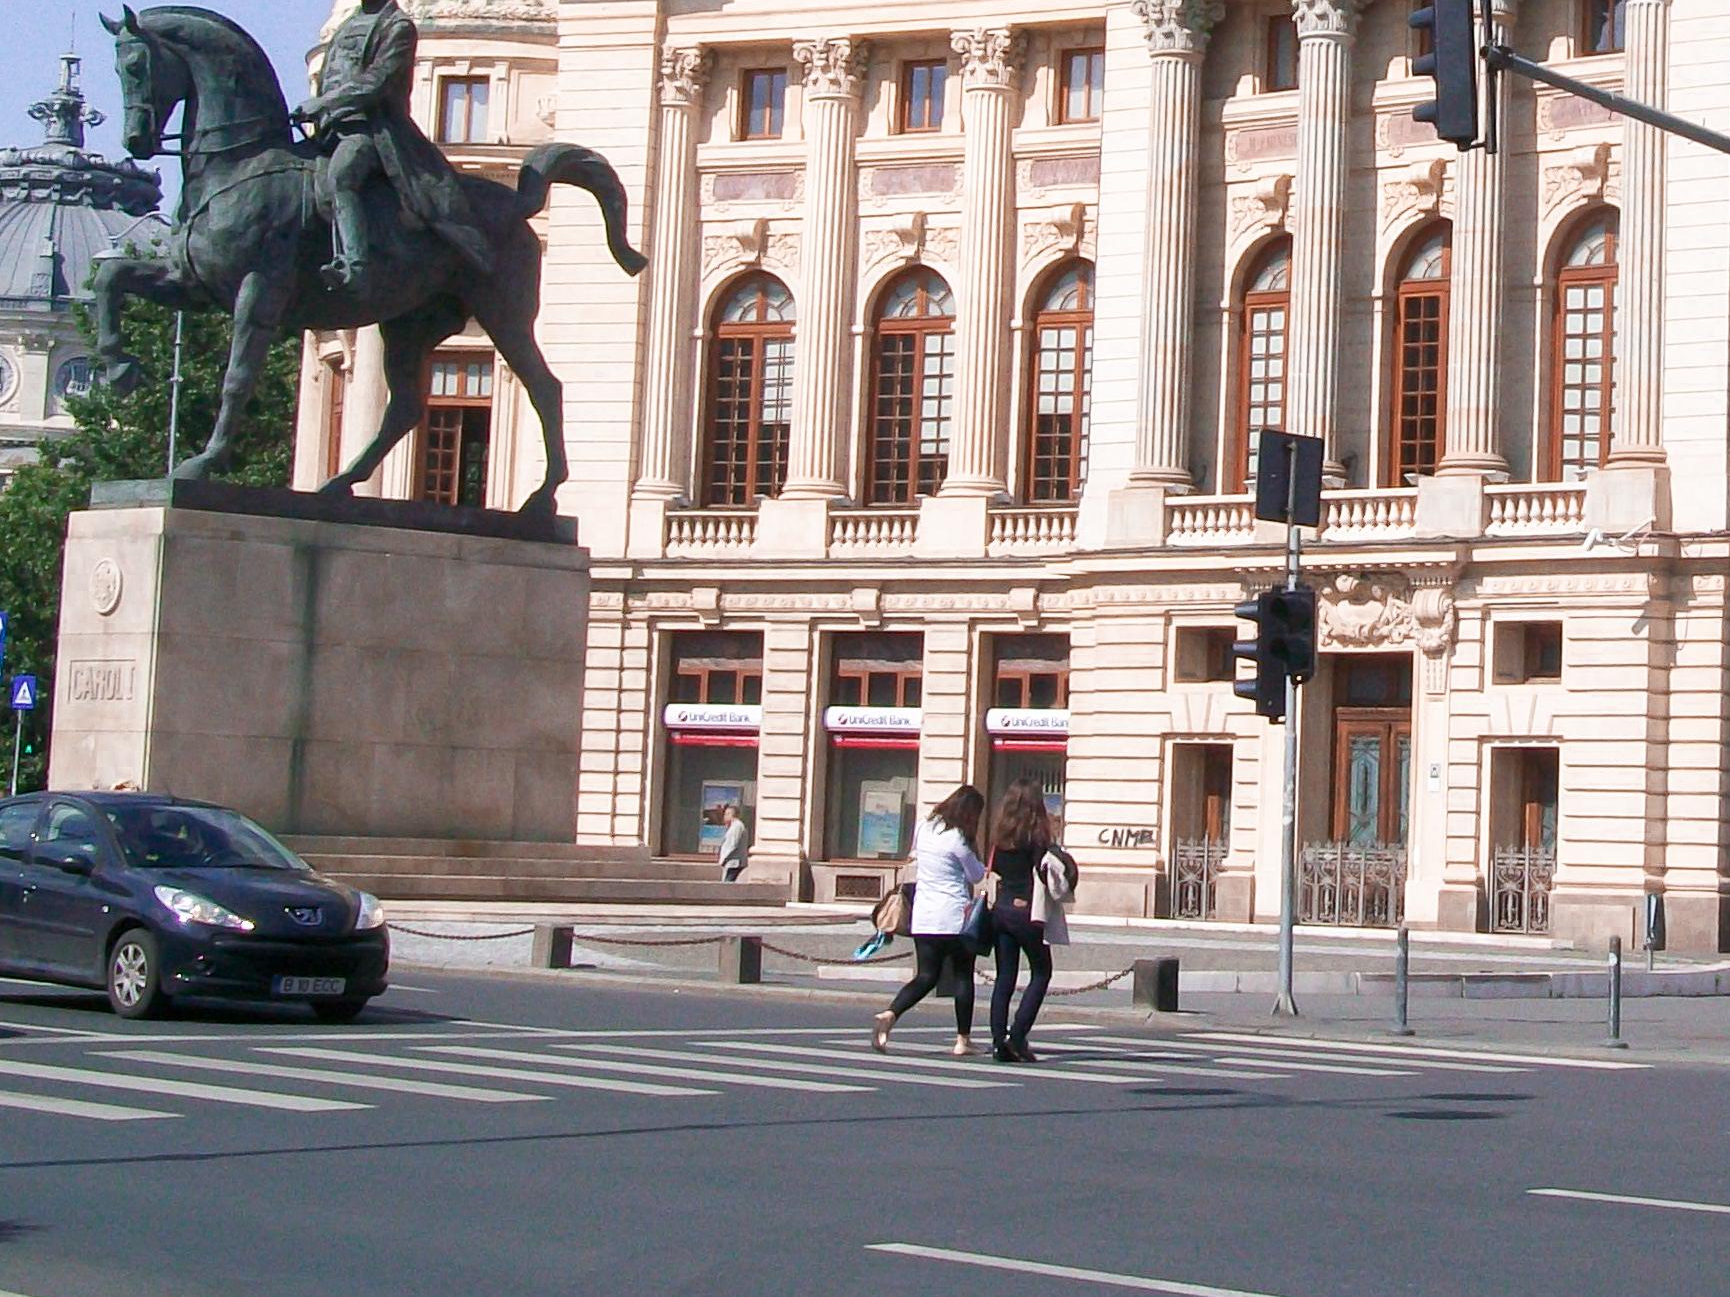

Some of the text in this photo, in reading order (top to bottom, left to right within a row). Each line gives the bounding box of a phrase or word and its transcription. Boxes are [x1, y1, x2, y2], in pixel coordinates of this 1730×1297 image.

[74, 666, 123, 701] CAROL
[689, 711, 751, 723] UniCredit Bank
[849, 714, 911, 726] UniCredit Bank
[1012, 716, 1069, 728] UniCredit Ban
